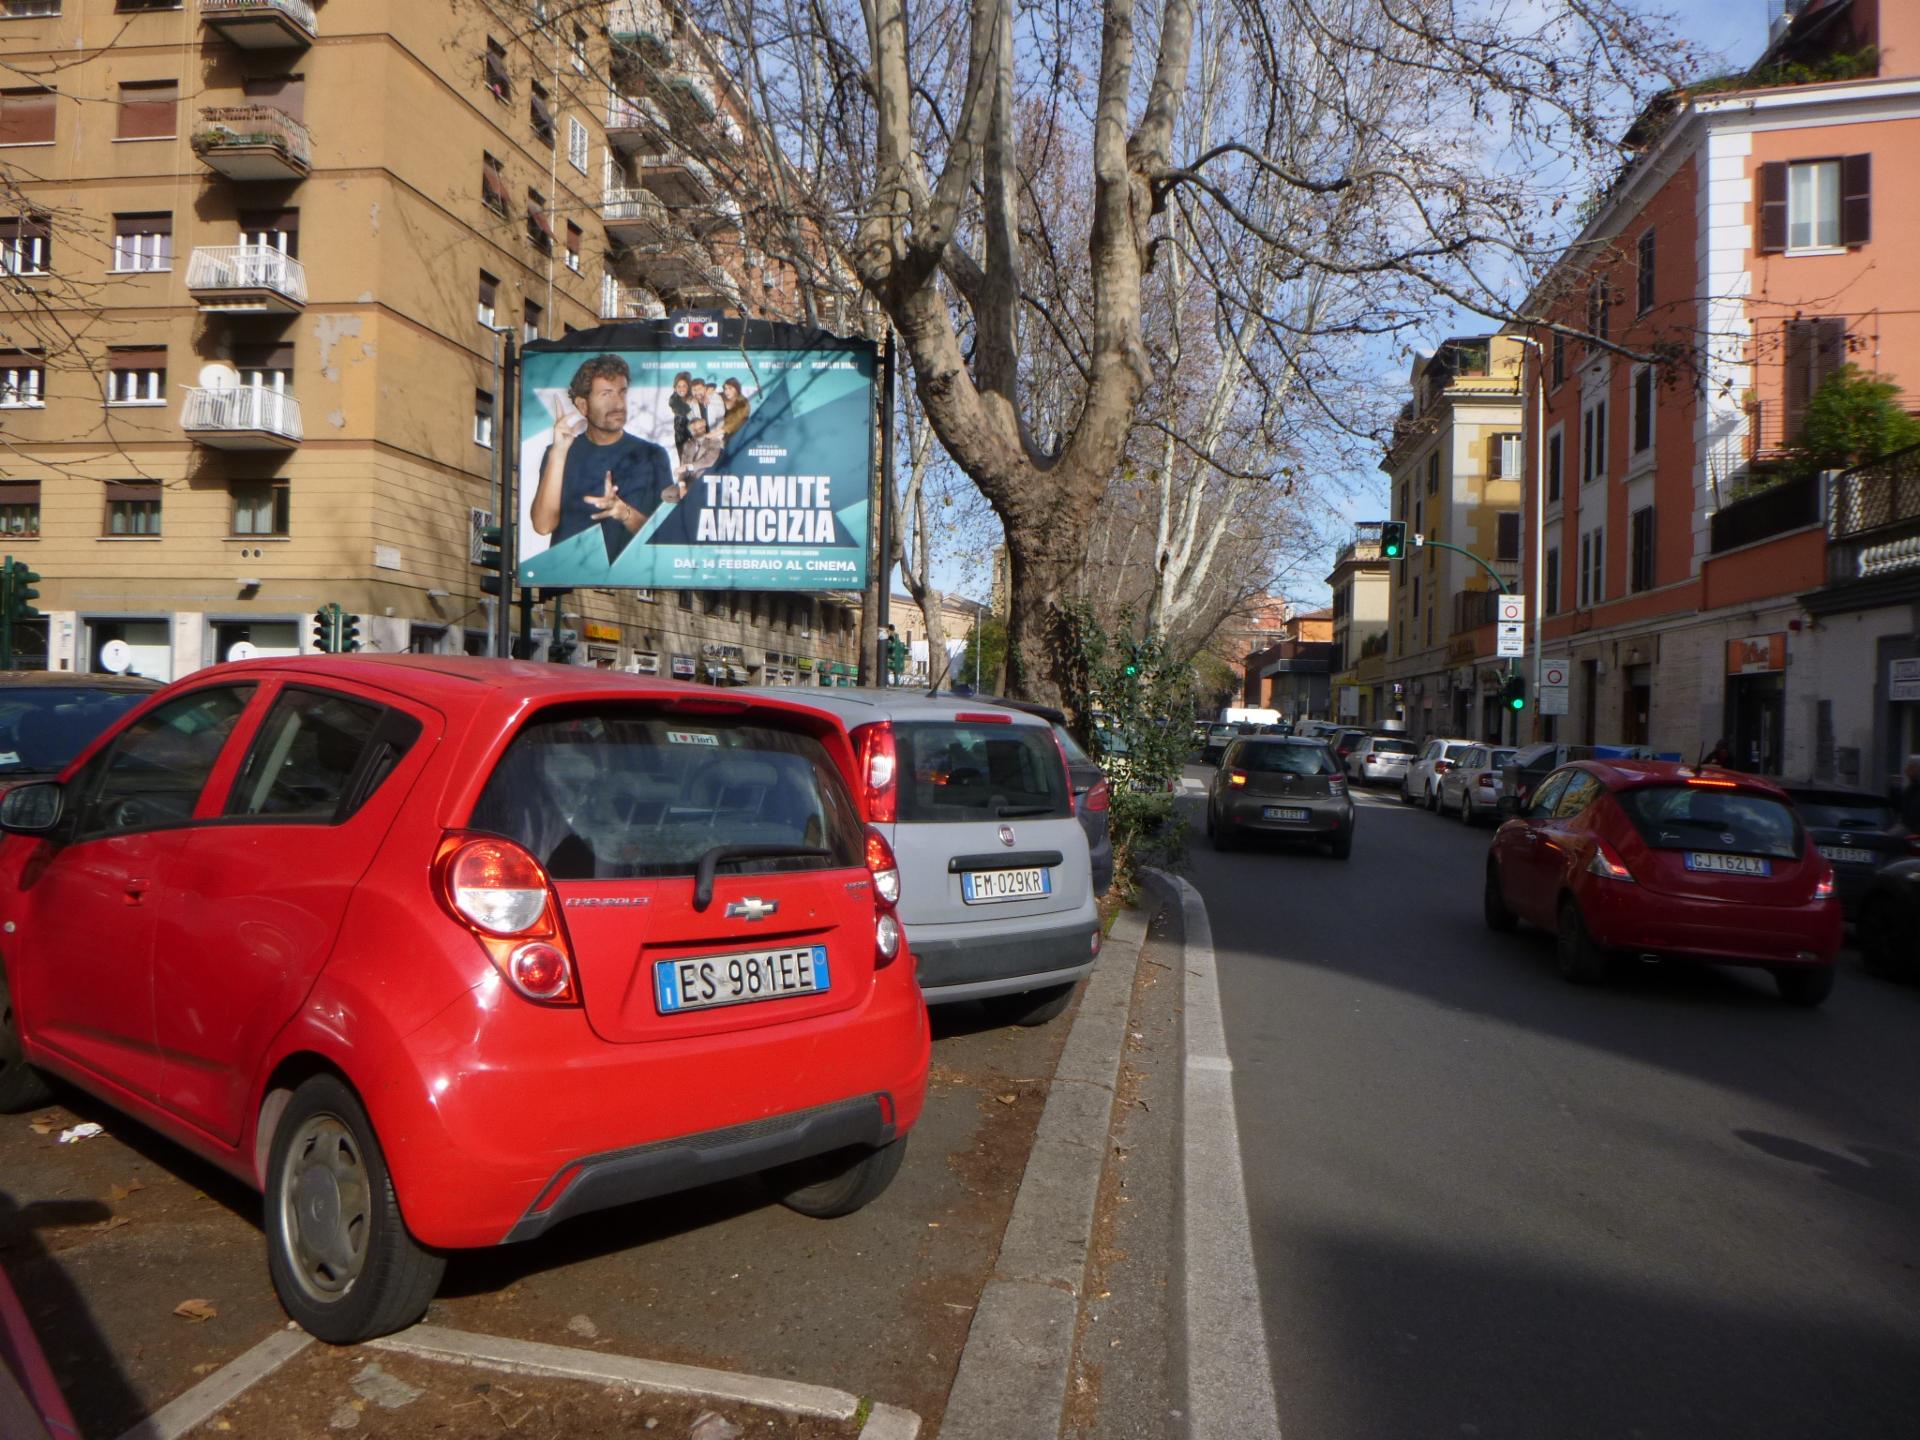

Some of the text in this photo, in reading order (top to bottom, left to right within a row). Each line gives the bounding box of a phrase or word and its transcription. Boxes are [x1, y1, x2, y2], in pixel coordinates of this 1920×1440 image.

[702, 474, 831, 509] TRAMITE
[696, 508, 836, 543] AMICIZIA
[673, 558, 857, 572] DAL 14 FEBBRAIO AL CINEMA
[1717, 855, 1762, 873] 162LX
[974, 874, 993, 897] FM
[997, 871, 1041, 894] 029KR
[679, 963, 716, 1002] ES
[727, 952, 812, 996] 981EE
